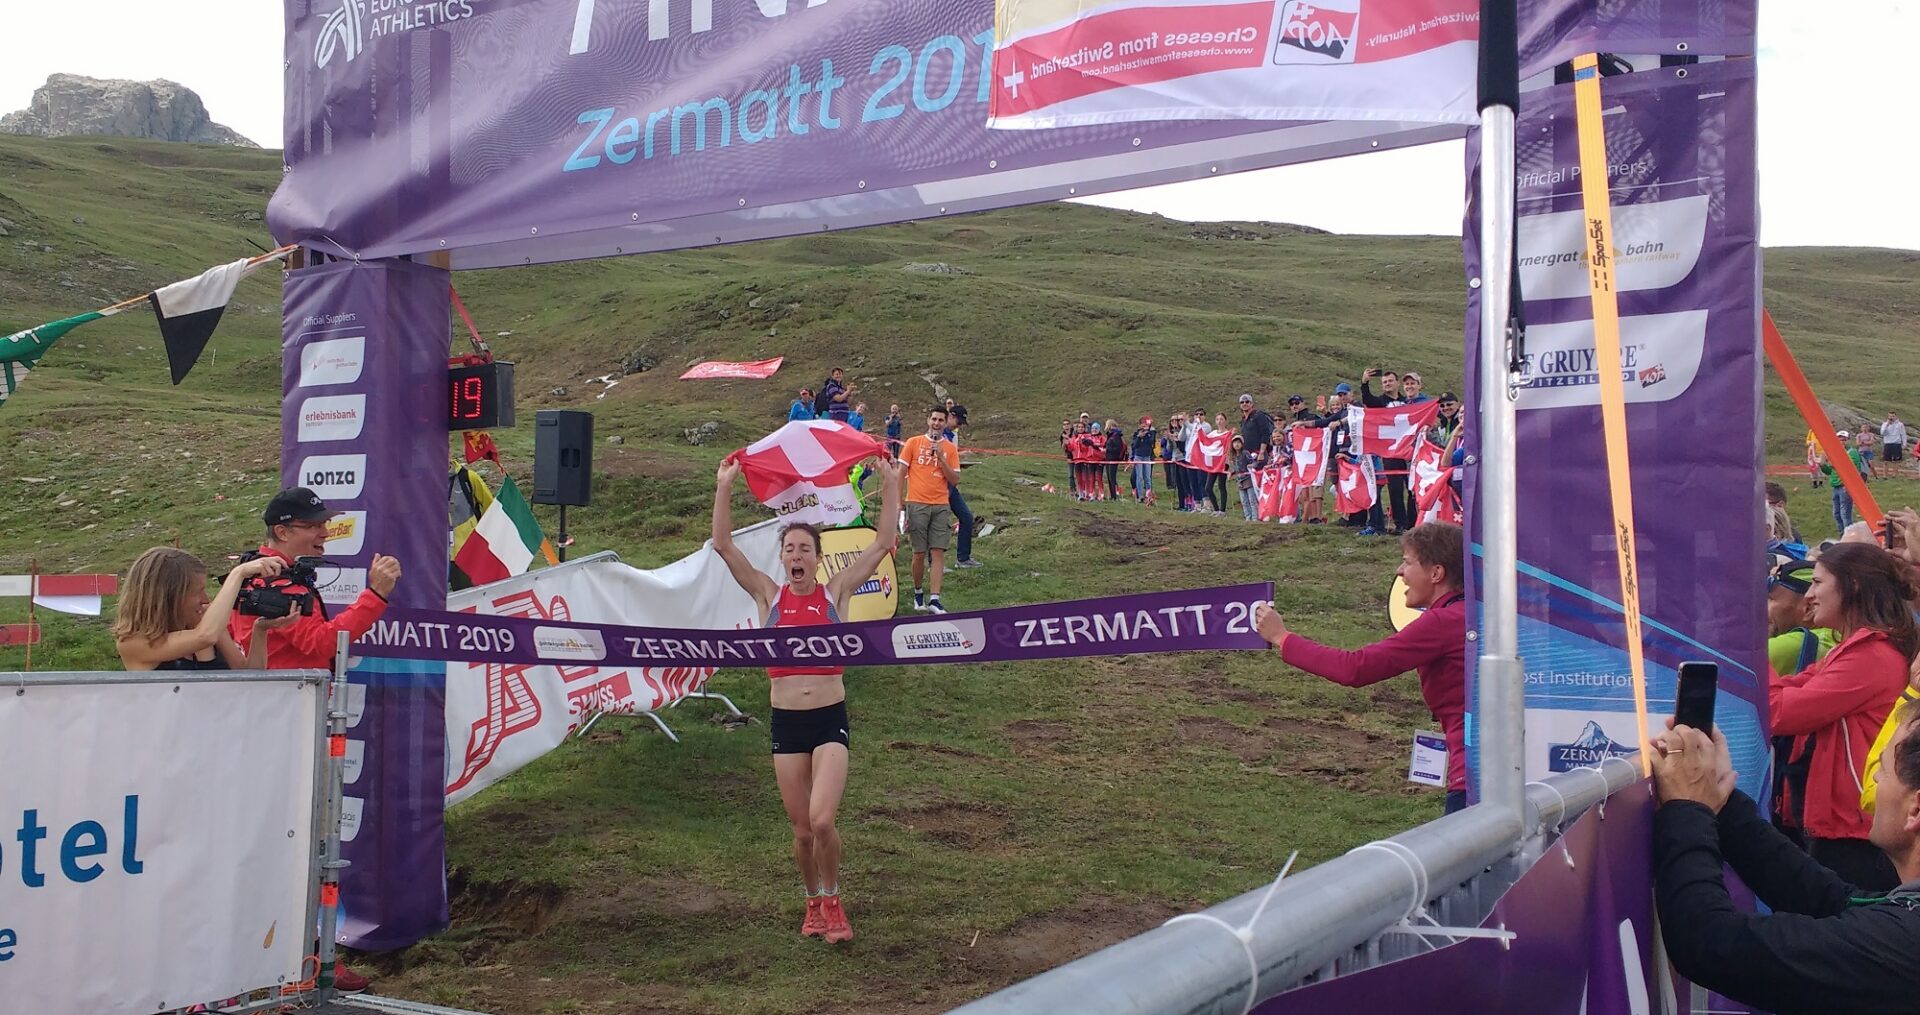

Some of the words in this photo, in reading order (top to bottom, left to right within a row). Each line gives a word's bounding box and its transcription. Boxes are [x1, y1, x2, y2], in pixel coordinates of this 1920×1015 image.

[370, 0, 473, 39] ATHLETICS
[563, 59, 843, 171] Zermatt
[863, 28, 994, 122] 201
[1571, 161, 1647, 180] Pners
[1519, 251, 1579, 266] rnergrat
[1626, 241, 1664, 256] bahn
[1589, 218, 1610, 267] SpanSet
[303, 315, 325, 326] Official
[326, 312, 356, 325] Suppliers
[306, 409, 356, 421] erlebnisbank
[329, 523, 352, 538] erBar
[353, 619, 450, 649] RMATT
[457, 625, 515, 652] 2019
[904, 635, 916, 644] LE
[917, 631, 959, 644] GRUYÈRE
[1014, 604, 1212, 647] ZERMATT
[624, 637, 776, 659] ZERMATT
[786, 634, 864, 658] 2019
[0, 795, 143, 887] tel
